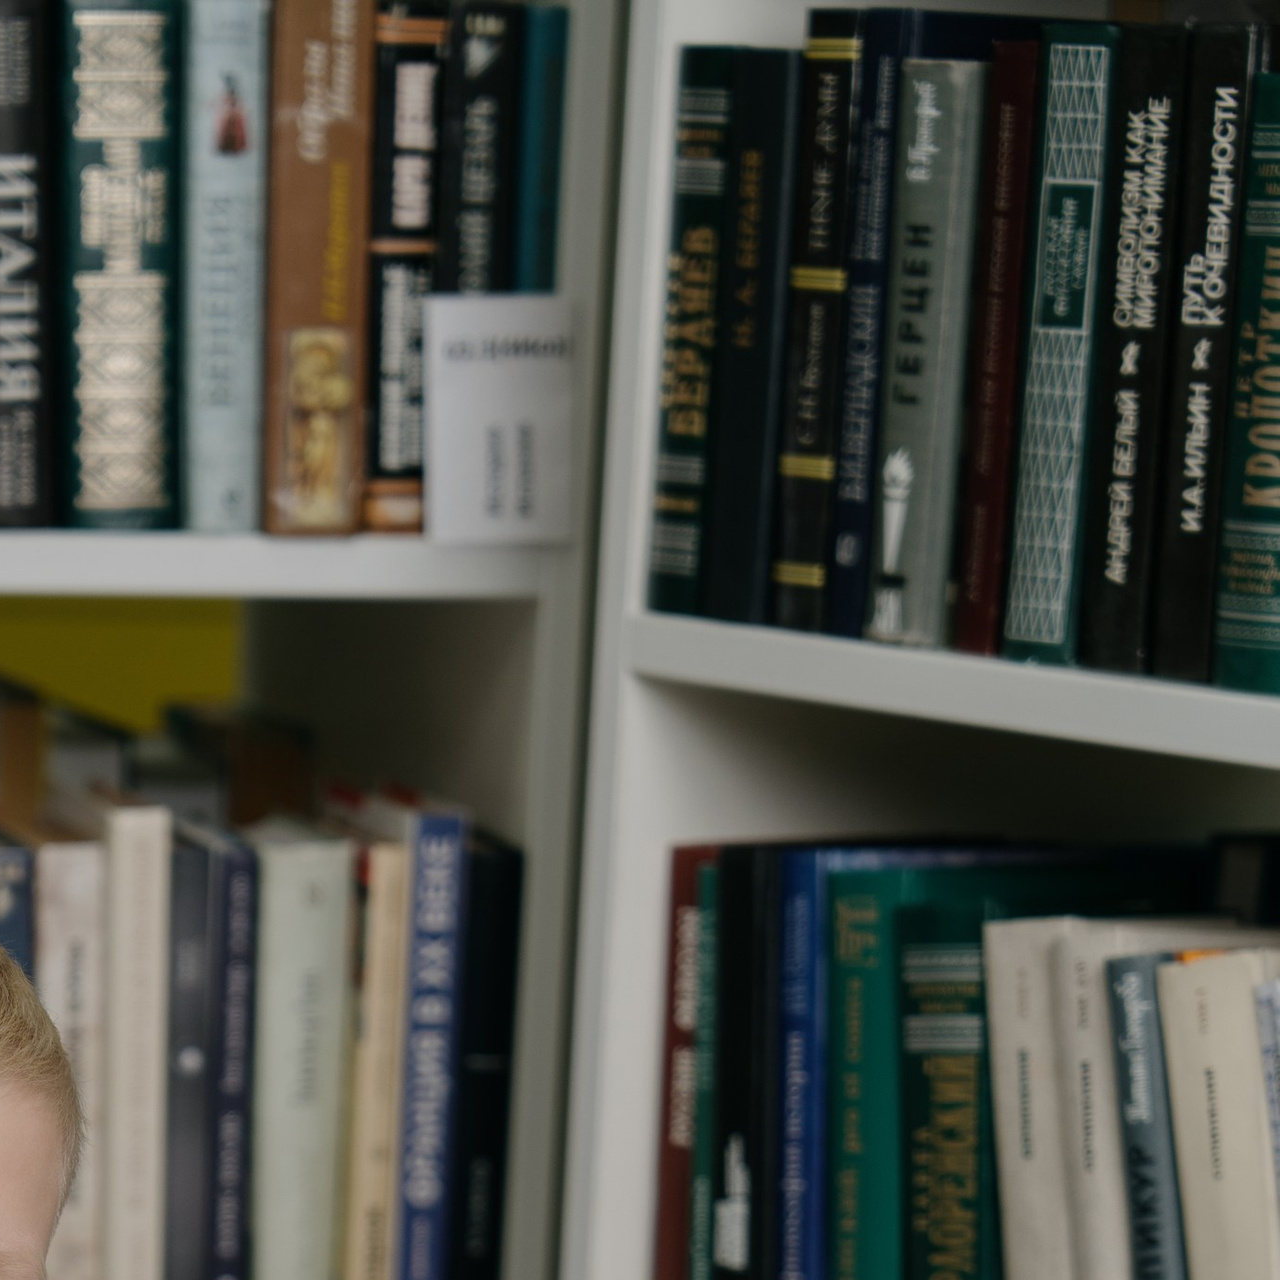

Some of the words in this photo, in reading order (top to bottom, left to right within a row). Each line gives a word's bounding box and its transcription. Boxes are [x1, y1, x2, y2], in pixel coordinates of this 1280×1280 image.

[1125, 110, 1150, 165] КАК
[1204, 85, 1240, 299] ОЧЕВИДНОСТИ
[734, 149, 765, 270] БЕРДЯЕВ
[1112, 169, 1146, 330] СИМВОЛИЗМ
[1132, 95, 1173, 329] МИРОПОНИМАНИЕ
[666, 220, 718, 438] БЕРДЯЕВ
[891, 219, 933, 408] ГЕРЦЕН
[1180, 254, 1207, 327] ПУТЬ
[1203, 304, 1227, 327] К
[1109, 388, 1141, 477] БЕЛЫЙ
[1241, 246, 1280, 509] КРОПО
[1179, 381, 1213, 534] И.А.ИЛЬИН
[1104, 482, 1134, 585] АНДРЕЙ
[417, 834, 458, 934] ВЕКЕ
